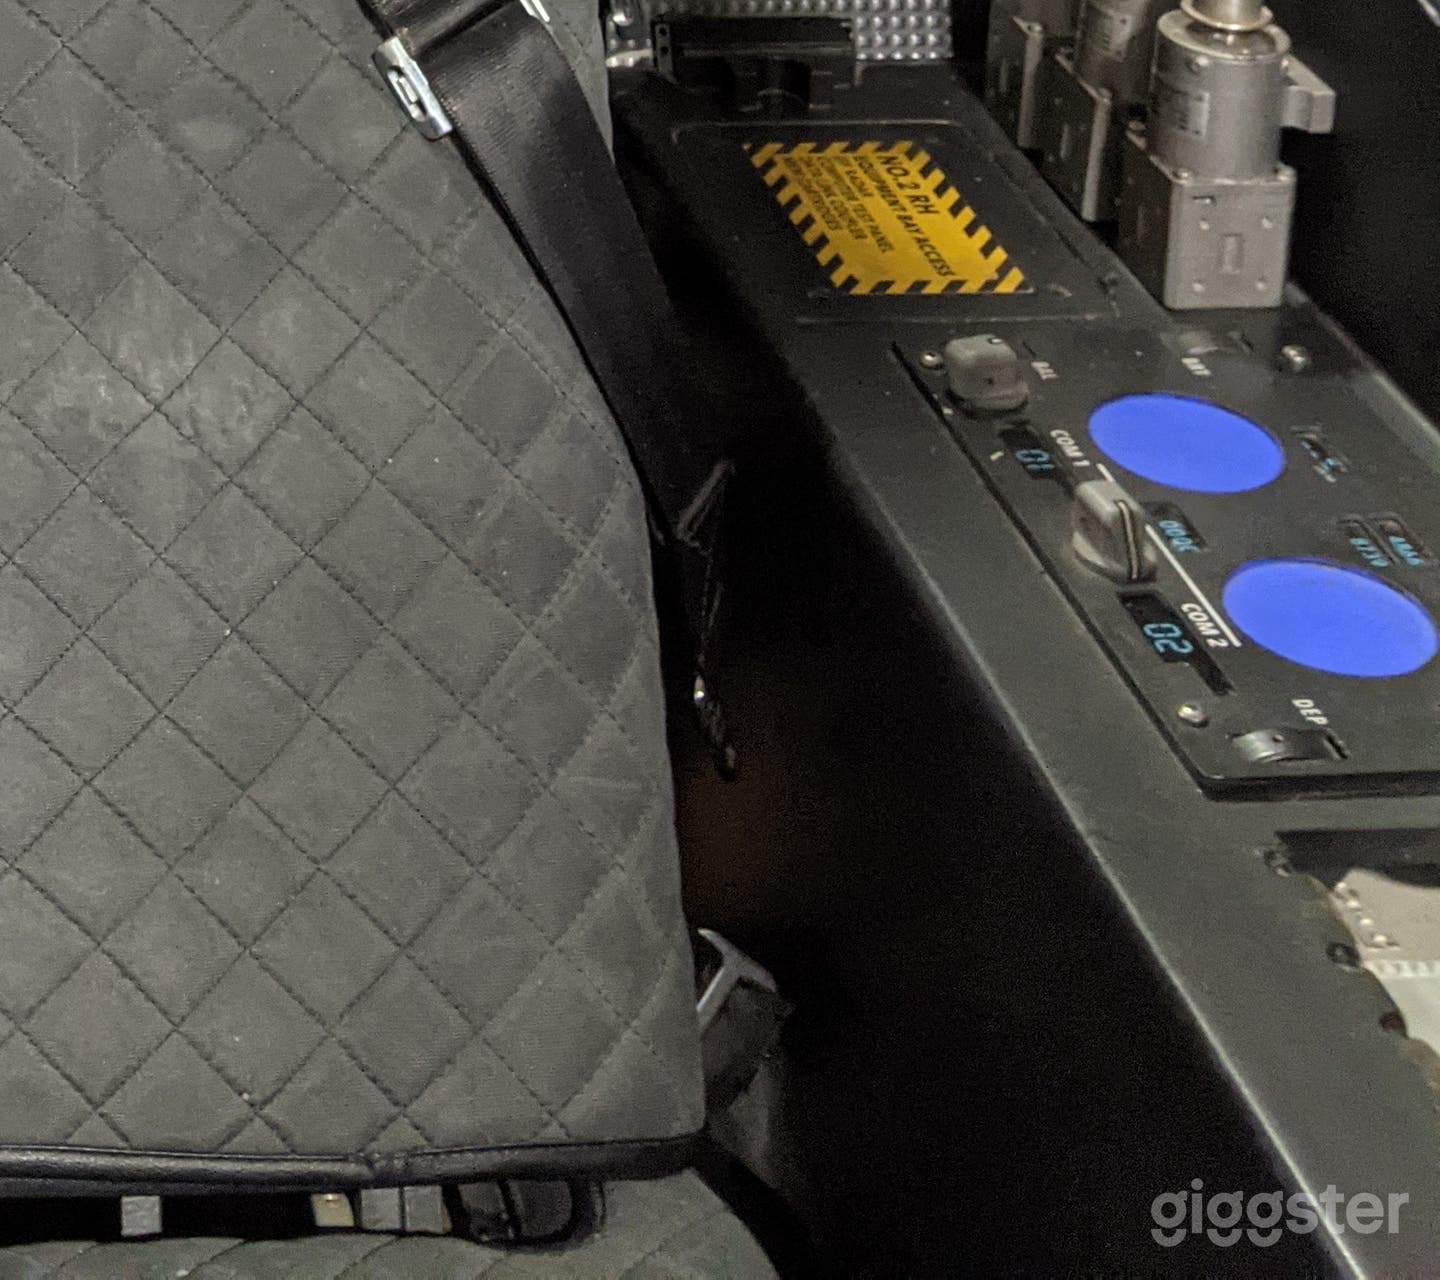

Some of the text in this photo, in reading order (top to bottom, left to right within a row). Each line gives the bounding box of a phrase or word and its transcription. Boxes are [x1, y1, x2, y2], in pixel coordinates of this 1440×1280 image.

[880, 155, 940, 215] NO.2 RH
[858, 156, 955, 277] EQUIPMENT BAY ACCESS
[1050, 429, 1090, 467] COM 1
[1142, 621, 1194, 655] 02
[1180, 603, 1229, 648] COM 2
[1292, 699, 1329, 725] DEP
